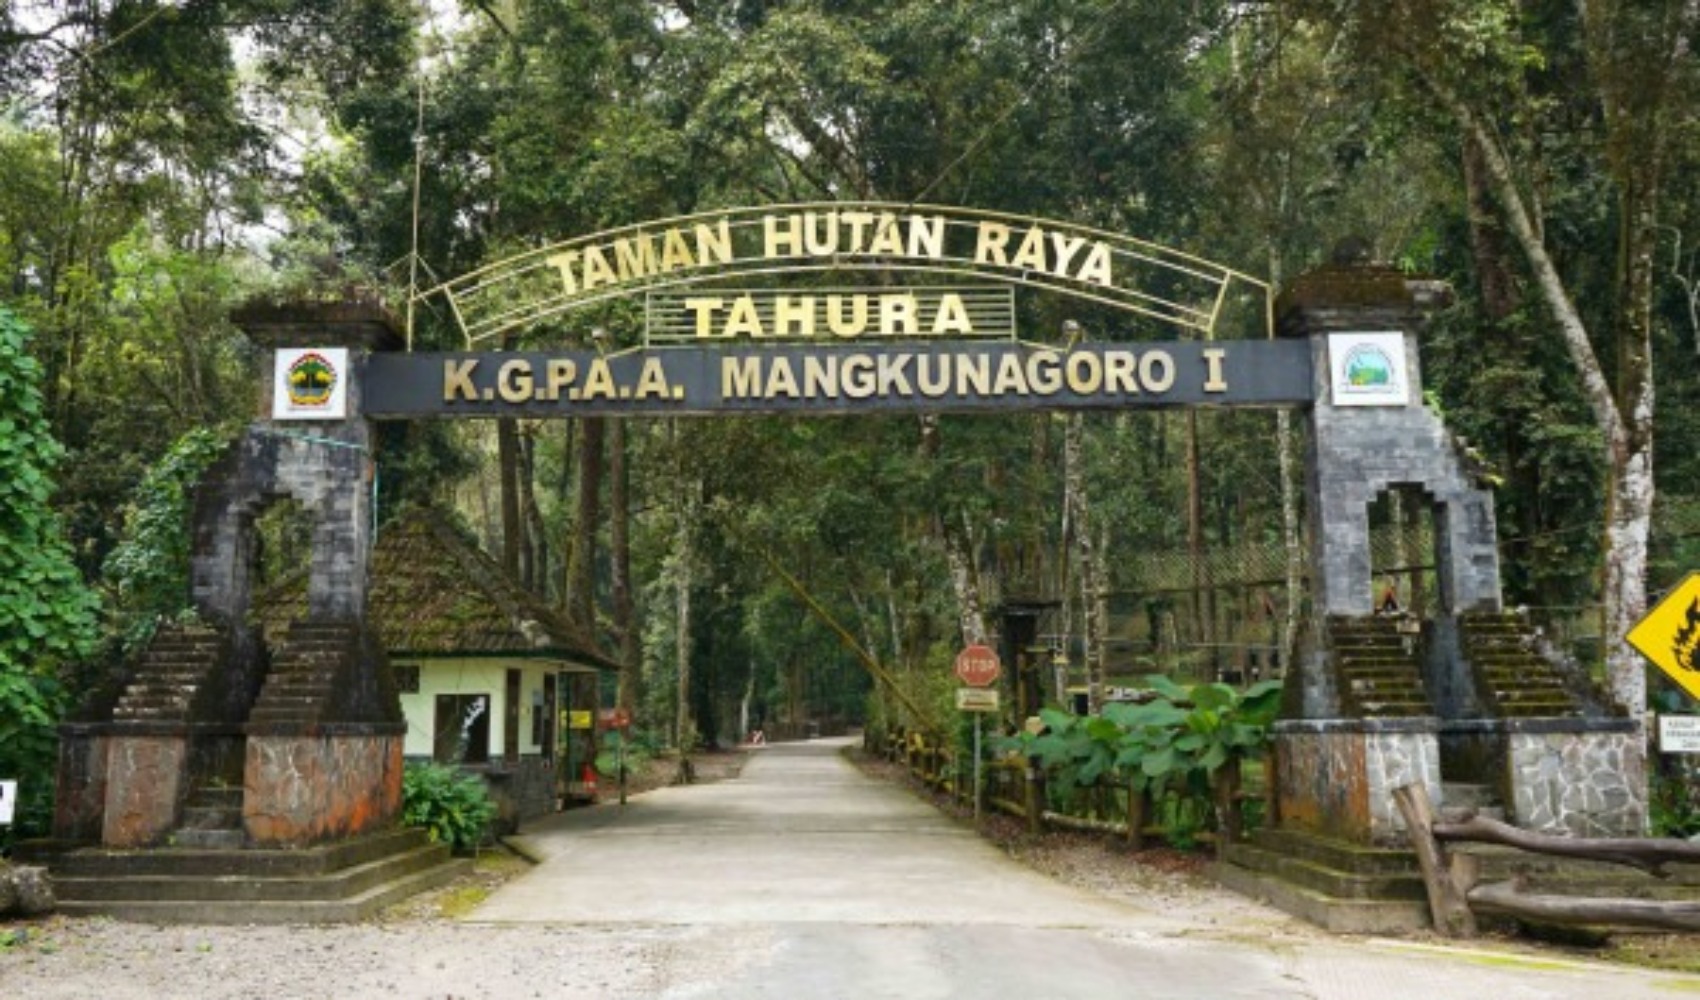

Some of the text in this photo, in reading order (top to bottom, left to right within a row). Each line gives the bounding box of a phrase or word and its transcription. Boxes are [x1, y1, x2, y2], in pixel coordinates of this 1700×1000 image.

[546, 211, 1112, 295] TAMAN HUTAN RAYA
[685, 293, 973, 338] TAHURA
[443, 349, 1228, 402] K.G.P.A.A. MANGKUNAGORO I
[962, 657, 995, 673] STOP
